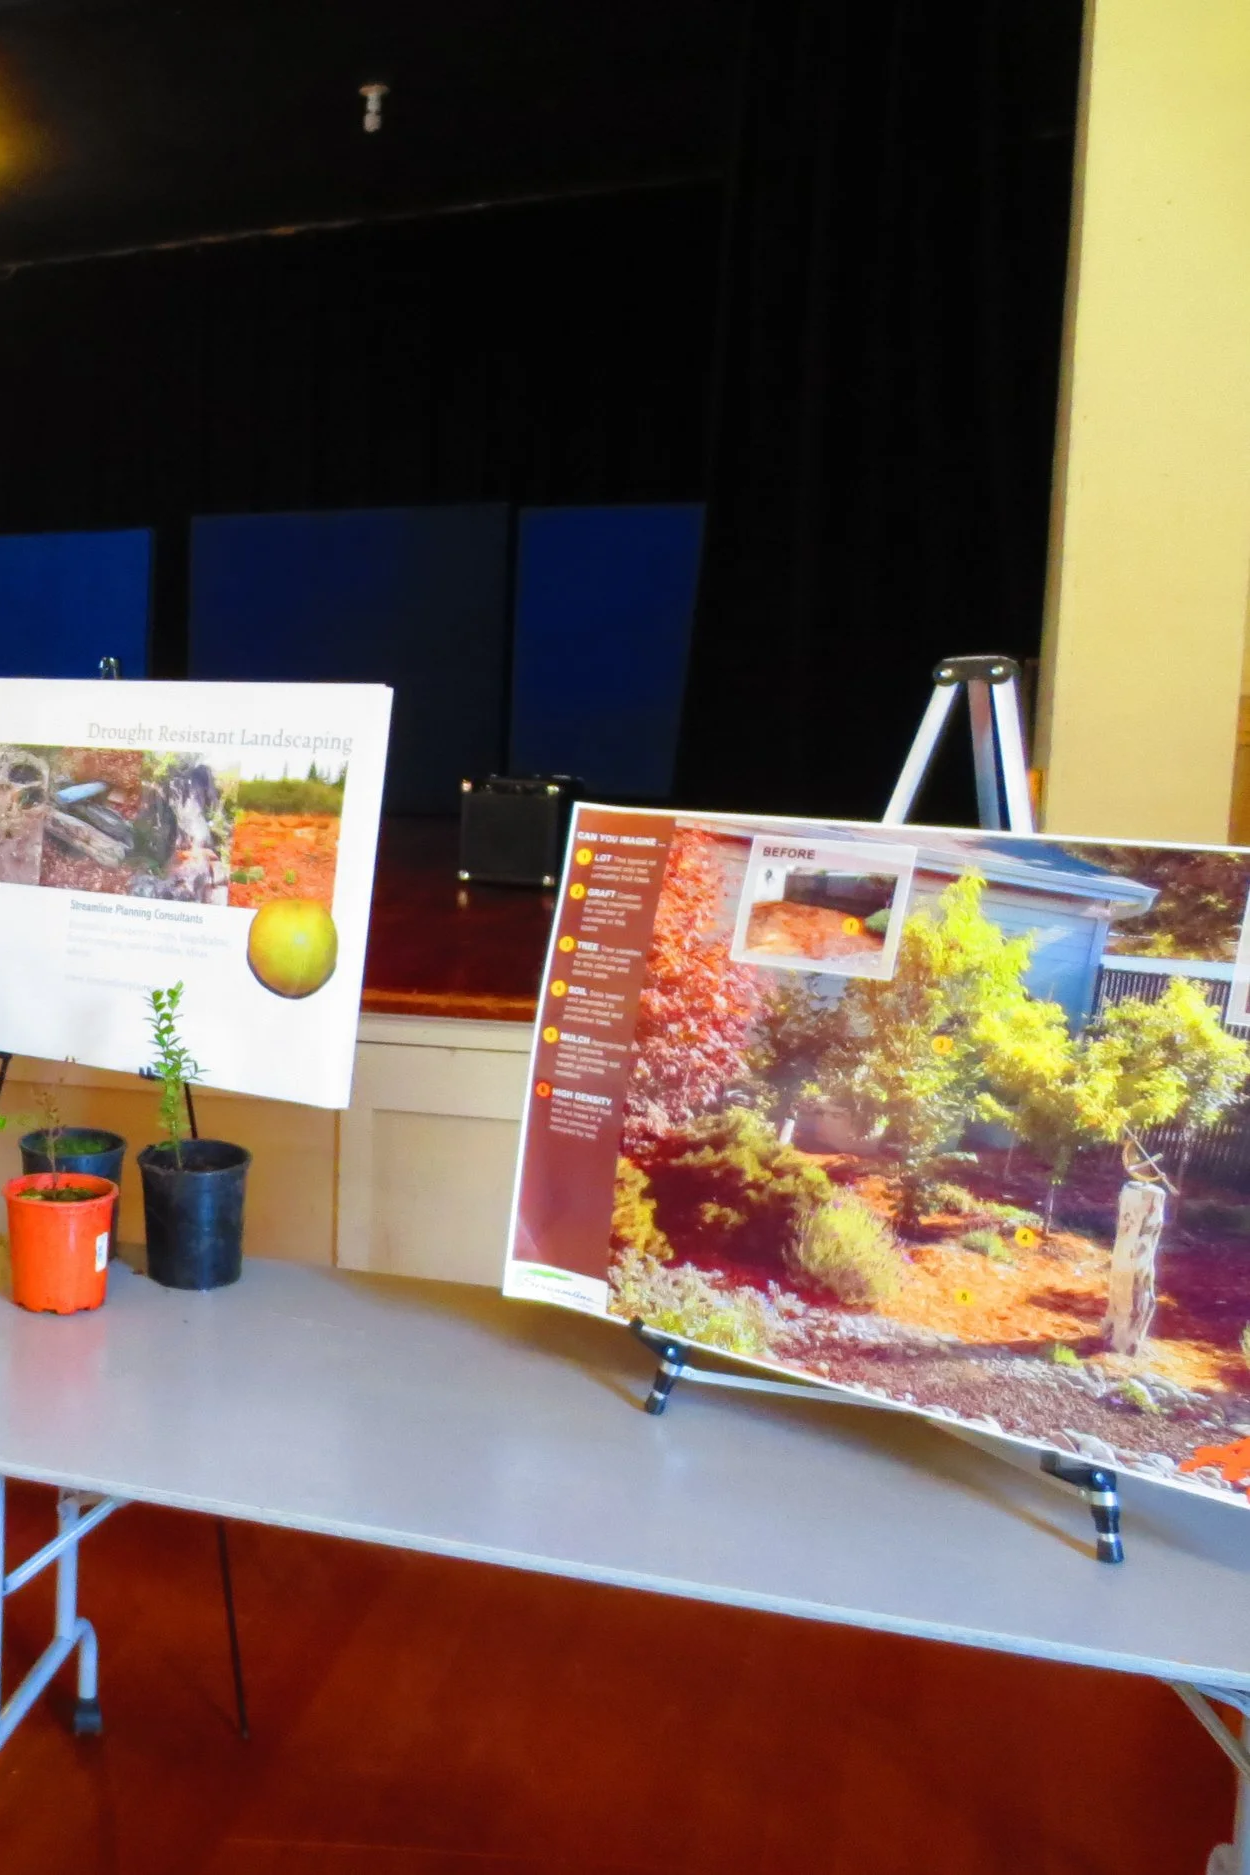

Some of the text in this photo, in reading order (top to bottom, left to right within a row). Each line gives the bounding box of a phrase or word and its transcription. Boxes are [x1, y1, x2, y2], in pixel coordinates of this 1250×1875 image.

[87, 722, 354, 755] Drought Resistant Landscaping
[577, 831, 598, 842] CAN
[599, 833, 618, 844] YOU
[619, 836, 657, 847] IMAGINE
[594, 853, 612, 863] LOT
[762, 846, 816, 860] BEFORE
[587, 887, 617, 899] GRAFT
[70, 898, 204, 924] Streamline Planning Consultants
[560, 1031, 591, 1045] MULCH
[552, 1087, 574, 1100] HIGH
[574, 1091, 613, 1106] DENSITY
